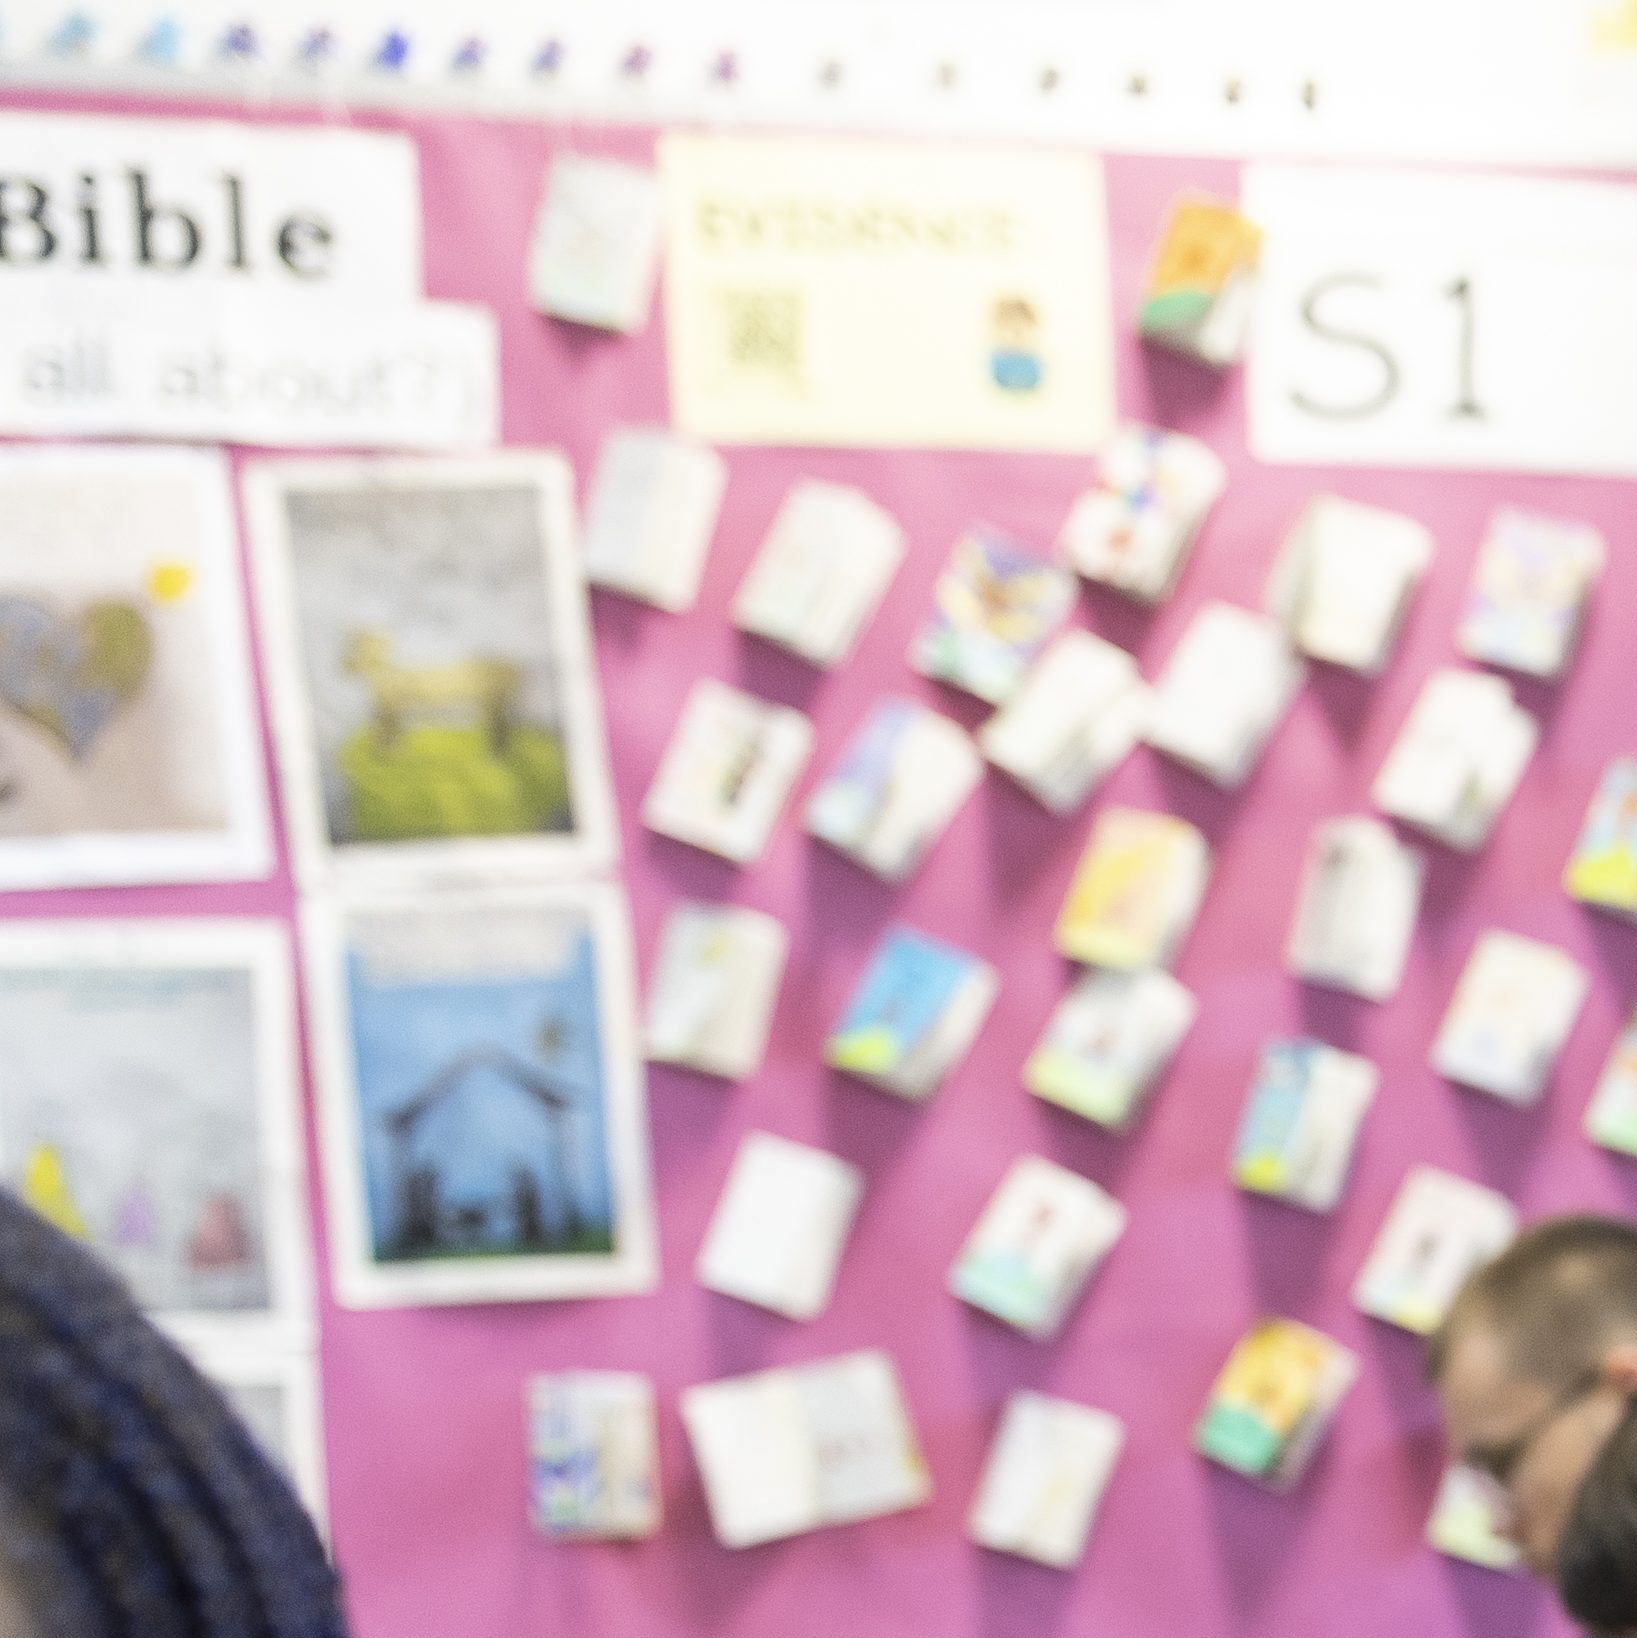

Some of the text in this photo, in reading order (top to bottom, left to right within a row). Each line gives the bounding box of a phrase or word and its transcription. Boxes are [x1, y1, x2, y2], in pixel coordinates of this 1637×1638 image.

[0, 166, 335, 279] Bible
[22, 333, 113, 402] all
[1289, 272, 1487, 420] S1
